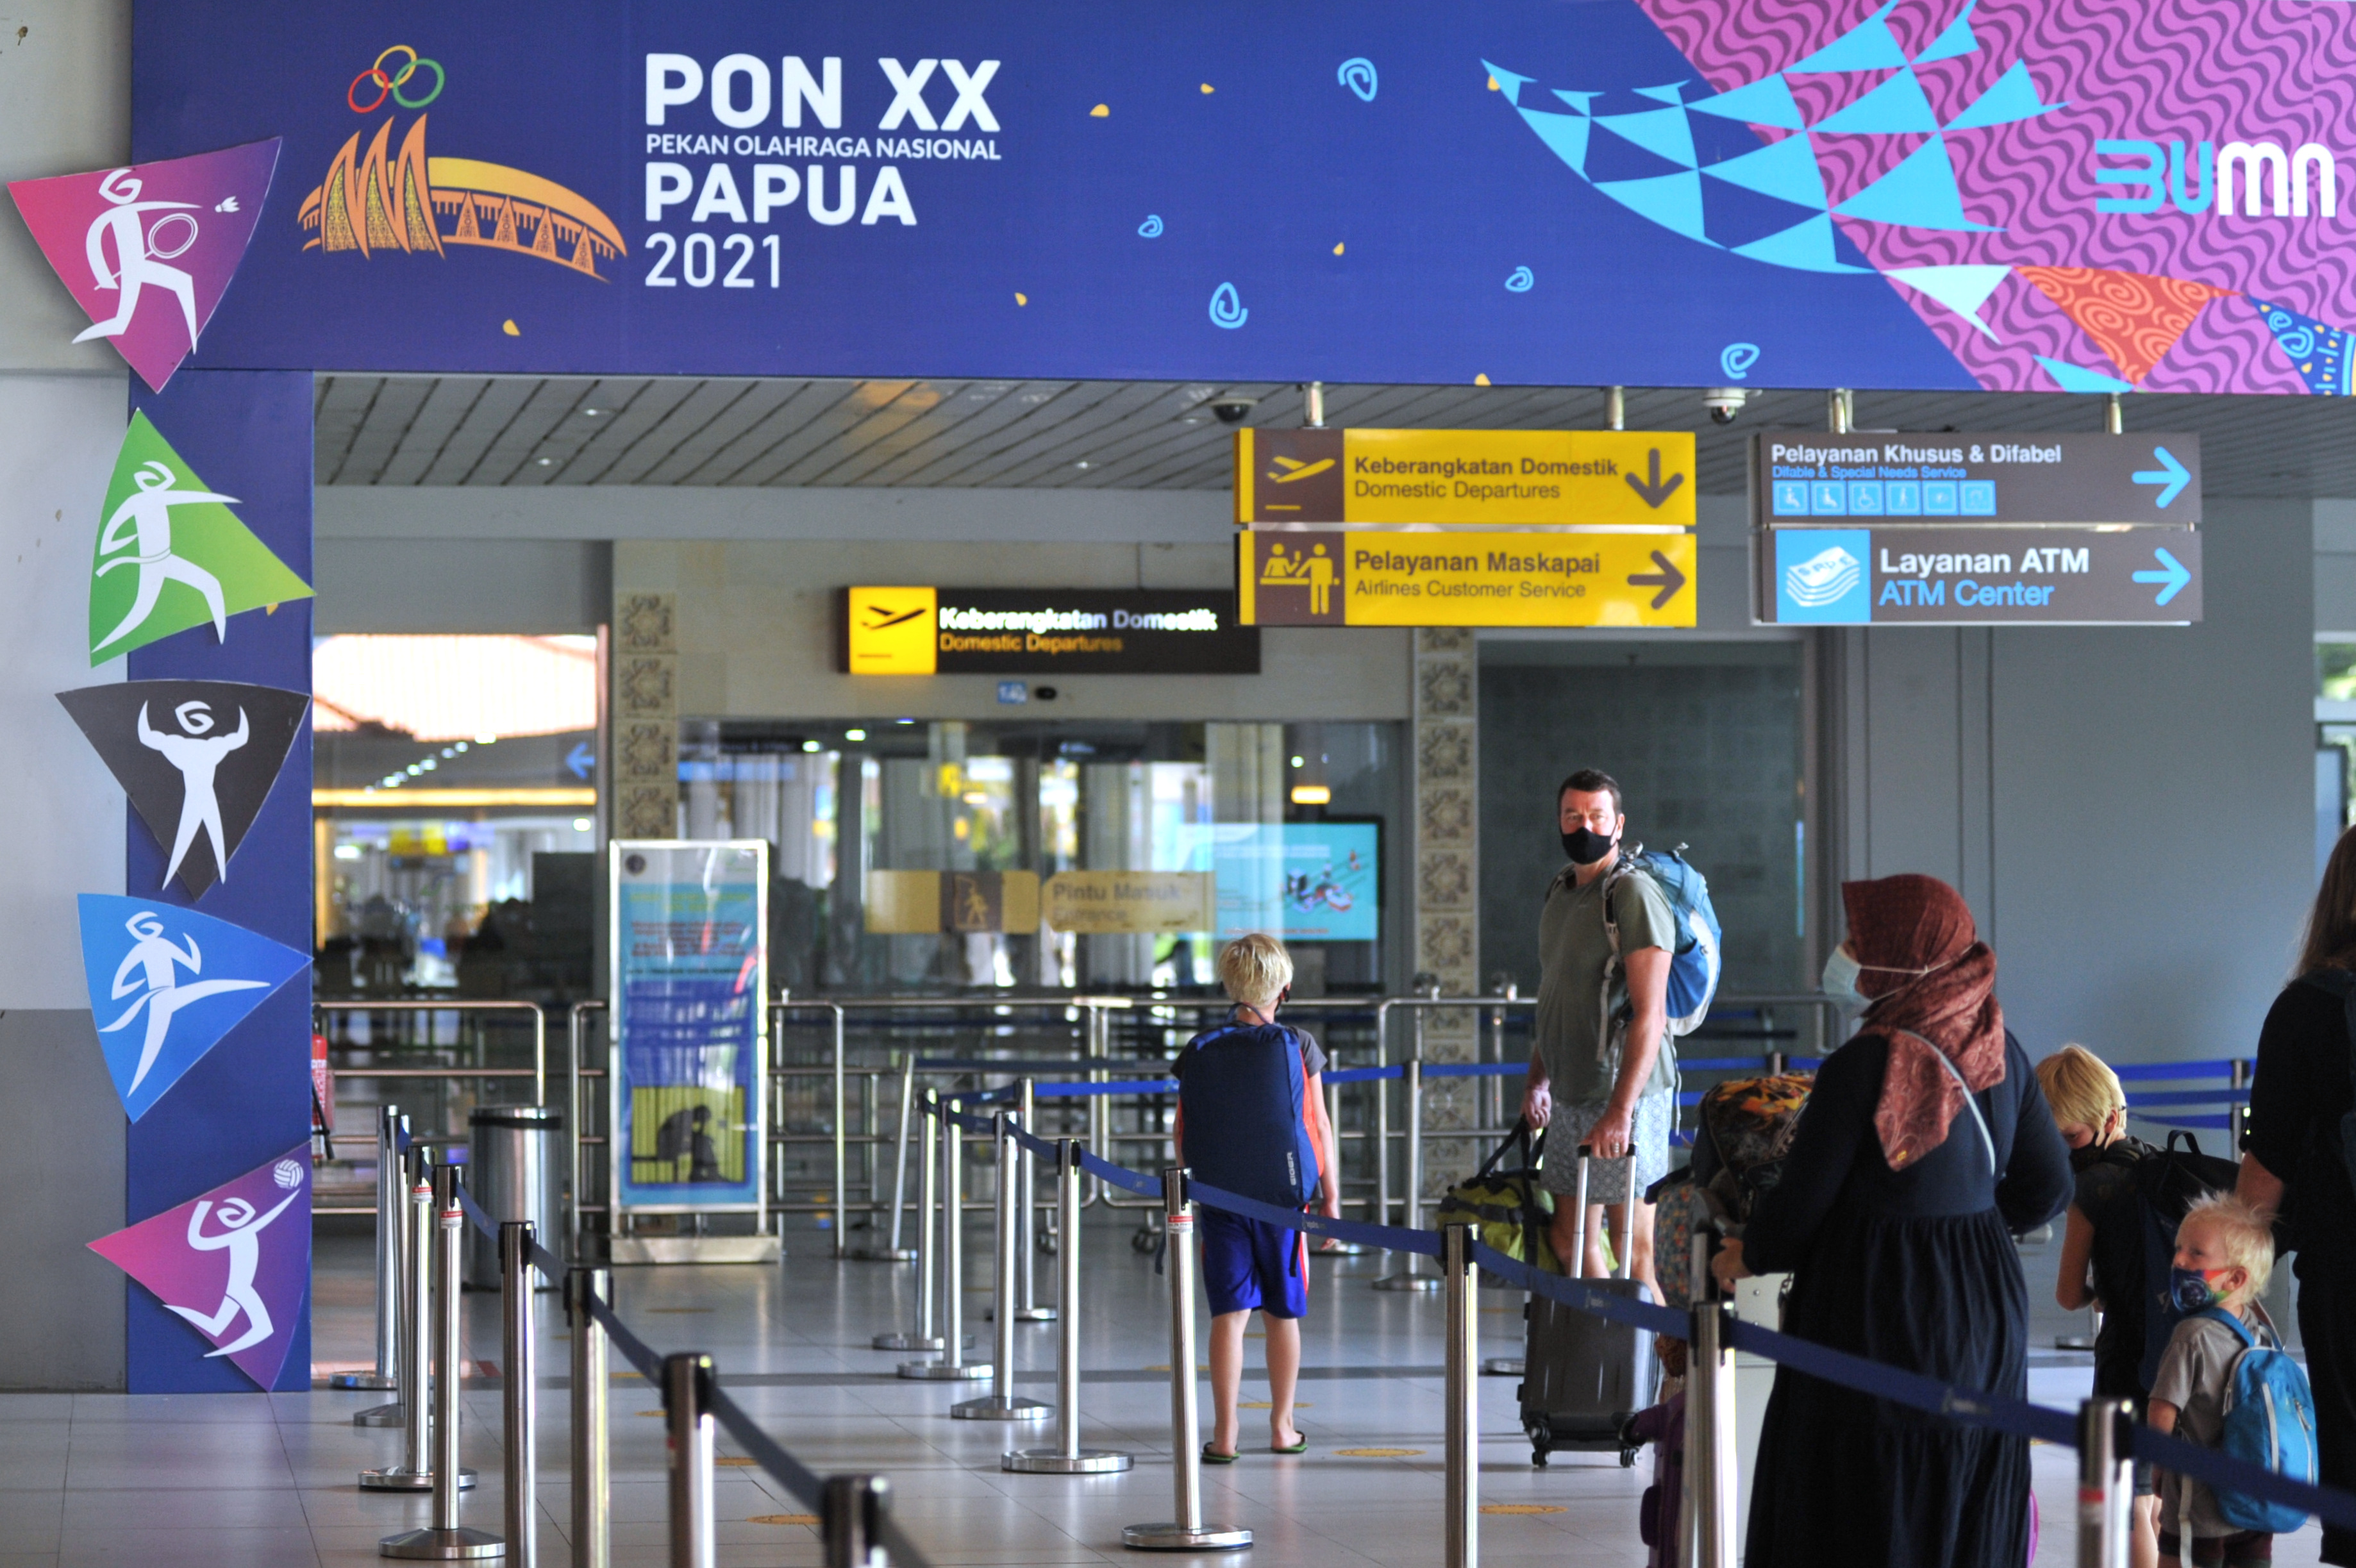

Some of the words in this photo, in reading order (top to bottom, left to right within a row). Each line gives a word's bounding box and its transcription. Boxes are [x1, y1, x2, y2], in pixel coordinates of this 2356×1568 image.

[645, 53, 842, 129] PON
[878, 57, 1001, 132] XX
[646, 134, 730, 155] PEKAN
[733, 135, 873, 158] OLAHRAGA
[876, 138, 1001, 160] NASIONAL
[2094, 138, 2337, 218] BUMN
[645, 162, 918, 226] PAPUA
[645, 232, 780, 288] 2021
[1771, 444, 1879, 465] Pelayanan
[1884, 444, 1964, 463] Khusus
[1969, 444, 1985, 463] &
[1990, 444, 2062, 464] Difabel
[1354, 456, 1514, 480] Keberangkatan
[1519, 456, 1619, 476] Domestik
[1771, 465, 1816, 478] Difable
[1817, 465, 1828, 478] &
[1830, 465, 1876, 480] Special
[1878, 465, 1919, 478] Needs
[1921, 465, 1968, 479] Service
[1355, 480, 1447, 498] Domestic
[1453, 480, 1560, 502] Departures
[1354, 549, 1479, 576] Pelayanan
[1486, 551, 1600, 578] Maskapai
[1880, 549, 2012, 578] Layanan
[2019, 548, 2090, 574] ATM
[1354, 578, 1422, 597] Airlines
[1426, 579, 1514, 597] Customer
[1519, 579, 1587, 598] Service
[1878, 580, 1946, 606] ATM
[1953, 580, 2055, 606] Center
[939, 607, 1108, 633] Keberangkatan
[1114, 608, 1219, 631] Domestik
[939, 633, 1023, 653] Domestic
[1026, 633, 1124, 655] Departures
[1053, 881, 1107, 901] Pintu
[1114, 882, 1182, 901] Masuk
[1287, 1151, 1297, 1185] EIGER
